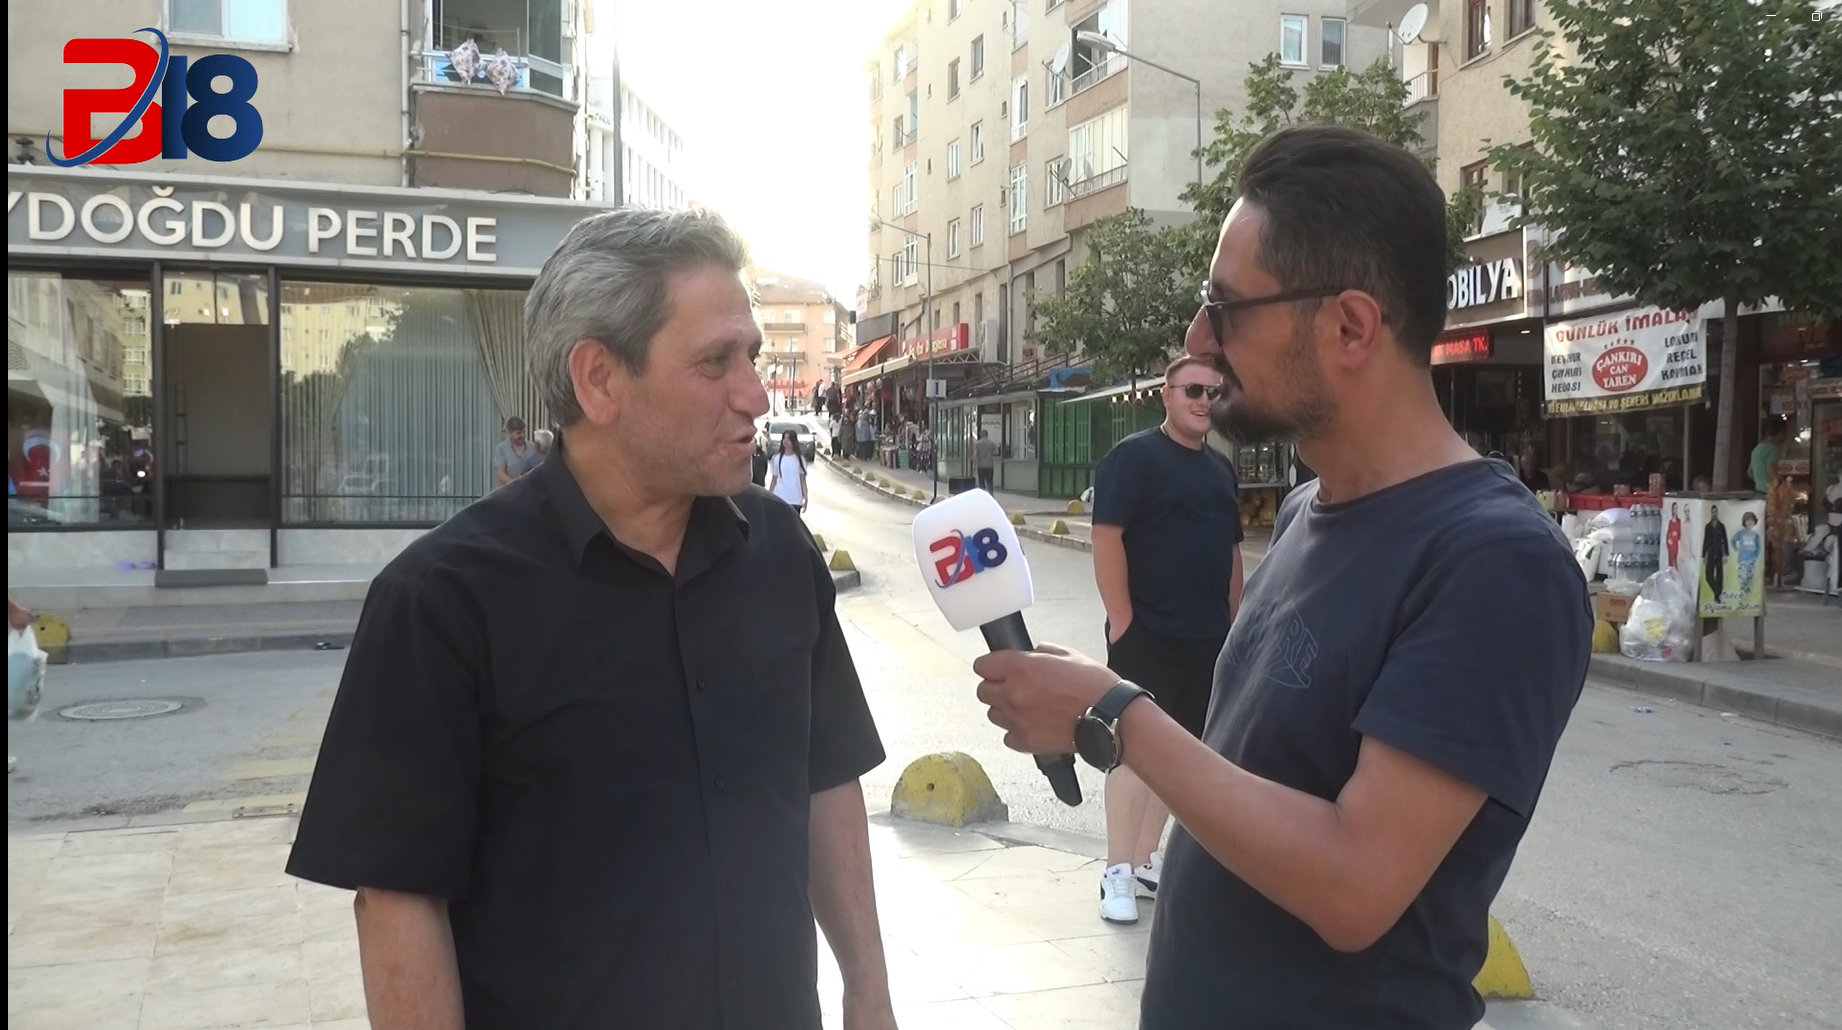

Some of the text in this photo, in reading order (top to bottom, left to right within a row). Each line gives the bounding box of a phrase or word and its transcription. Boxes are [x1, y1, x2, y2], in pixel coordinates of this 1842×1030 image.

[307, 207, 498, 262] PERDE
[1447, 256, 1519, 310] OBİLYA
[1556, 320, 1619, 343] GÜNLÜK
[1596, 350, 1643, 373] ÇANKIRI
[1609, 364, 1629, 375] CAN
[1603, 373, 1637, 389] YAREN
